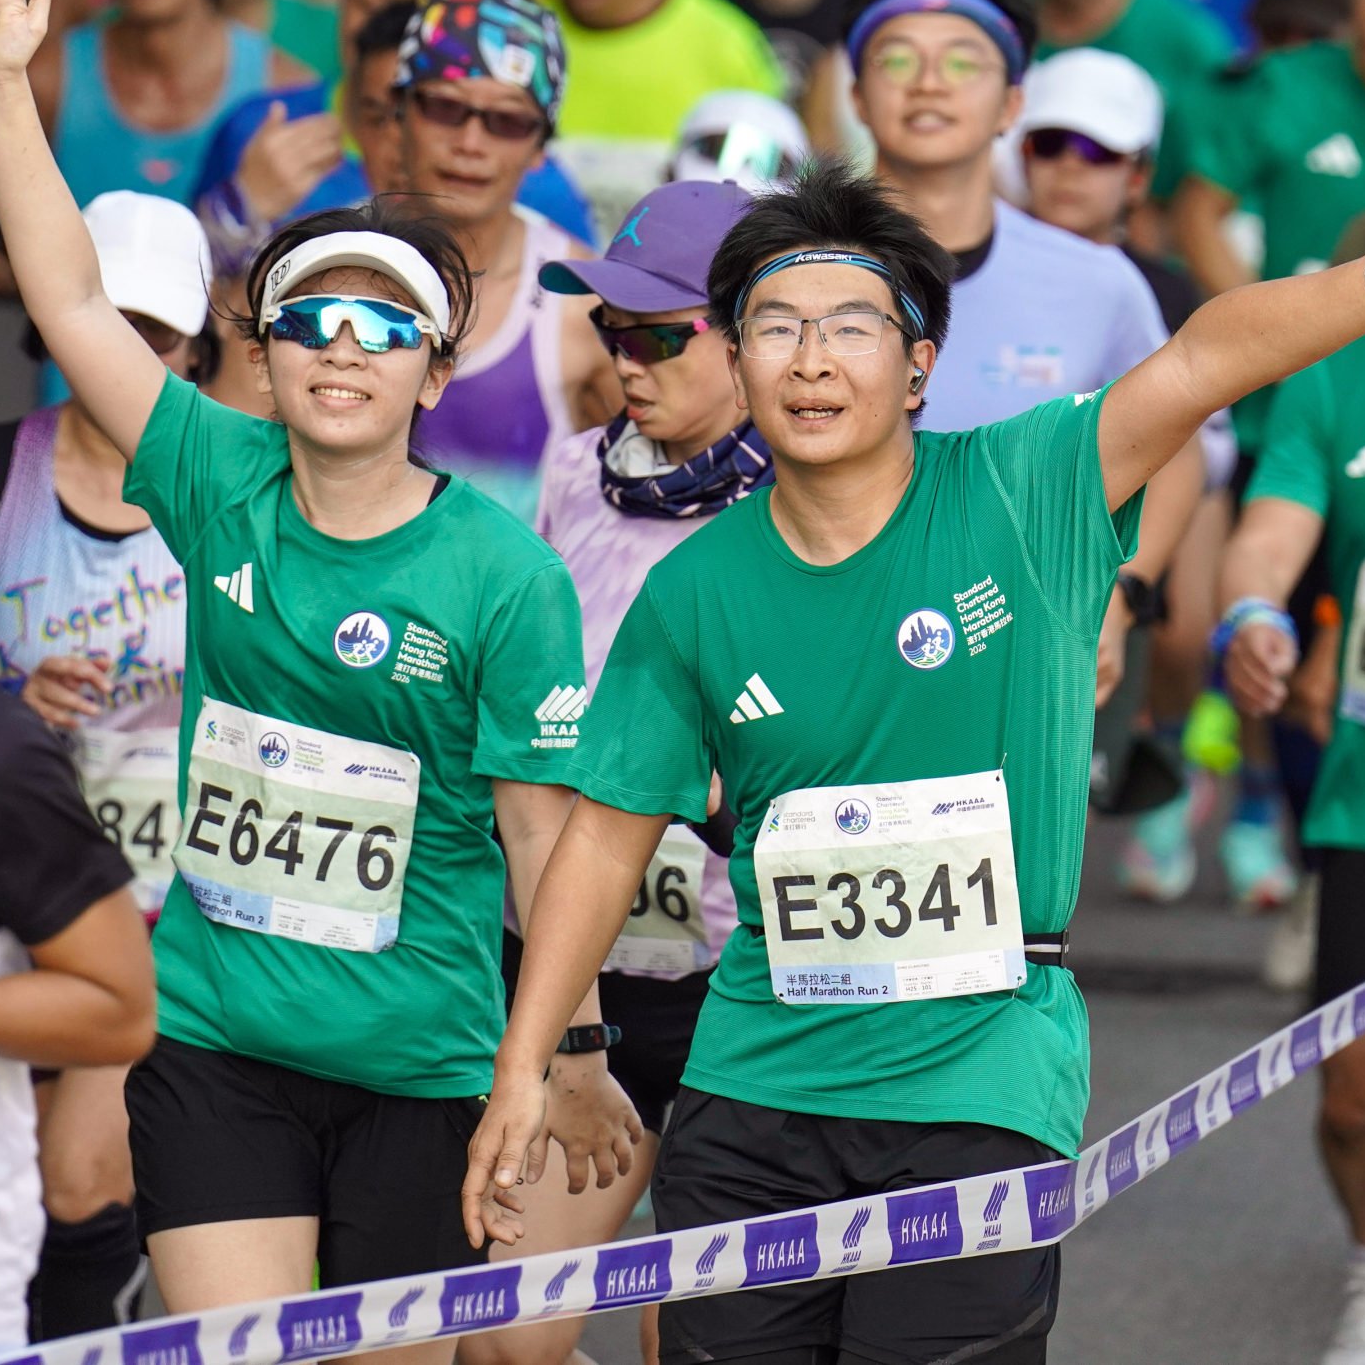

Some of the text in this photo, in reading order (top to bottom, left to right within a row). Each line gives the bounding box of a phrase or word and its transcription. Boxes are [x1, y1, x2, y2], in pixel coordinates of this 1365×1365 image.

[953, 575, 993, 603] Standard
[956, 583, 999, 613] Chartered
[960, 594, 1006, 625] Hong Kong
[962, 607, 1004, 635] Marathon
[406, 622, 449, 646] Standard
[397, 652, 440, 671] Marathon
[400, 641, 449, 665] Hong Kong
[968, 642, 987, 656] 2026
[391, 671, 411, 684] 2026
[369, 765, 399, 775] HKAAA
[956, 797, 985, 807] HKAAA
[186, 781, 397, 891] E6476
[772, 857, 998, 941] E3341
[235, 908, 255, 922] Run
[257, 915, 265, 925] 2
[786, 973, 852, 986] 半馬拉松二組
[787, 985, 888, 997] Half Marathon Run 2
[1038, 1183, 1071, 1219] HKAAA
[901, 1211, 948, 1245] HKAAA
[983, 1223, 1002, 1238] HKAAA
[756, 1237, 805, 1272] HKAAA
[606, 1262, 658, 1298] HKAAA
[452, 1288, 506, 1325] HKAAA
[291, 1314, 347, 1350] HKAAA
